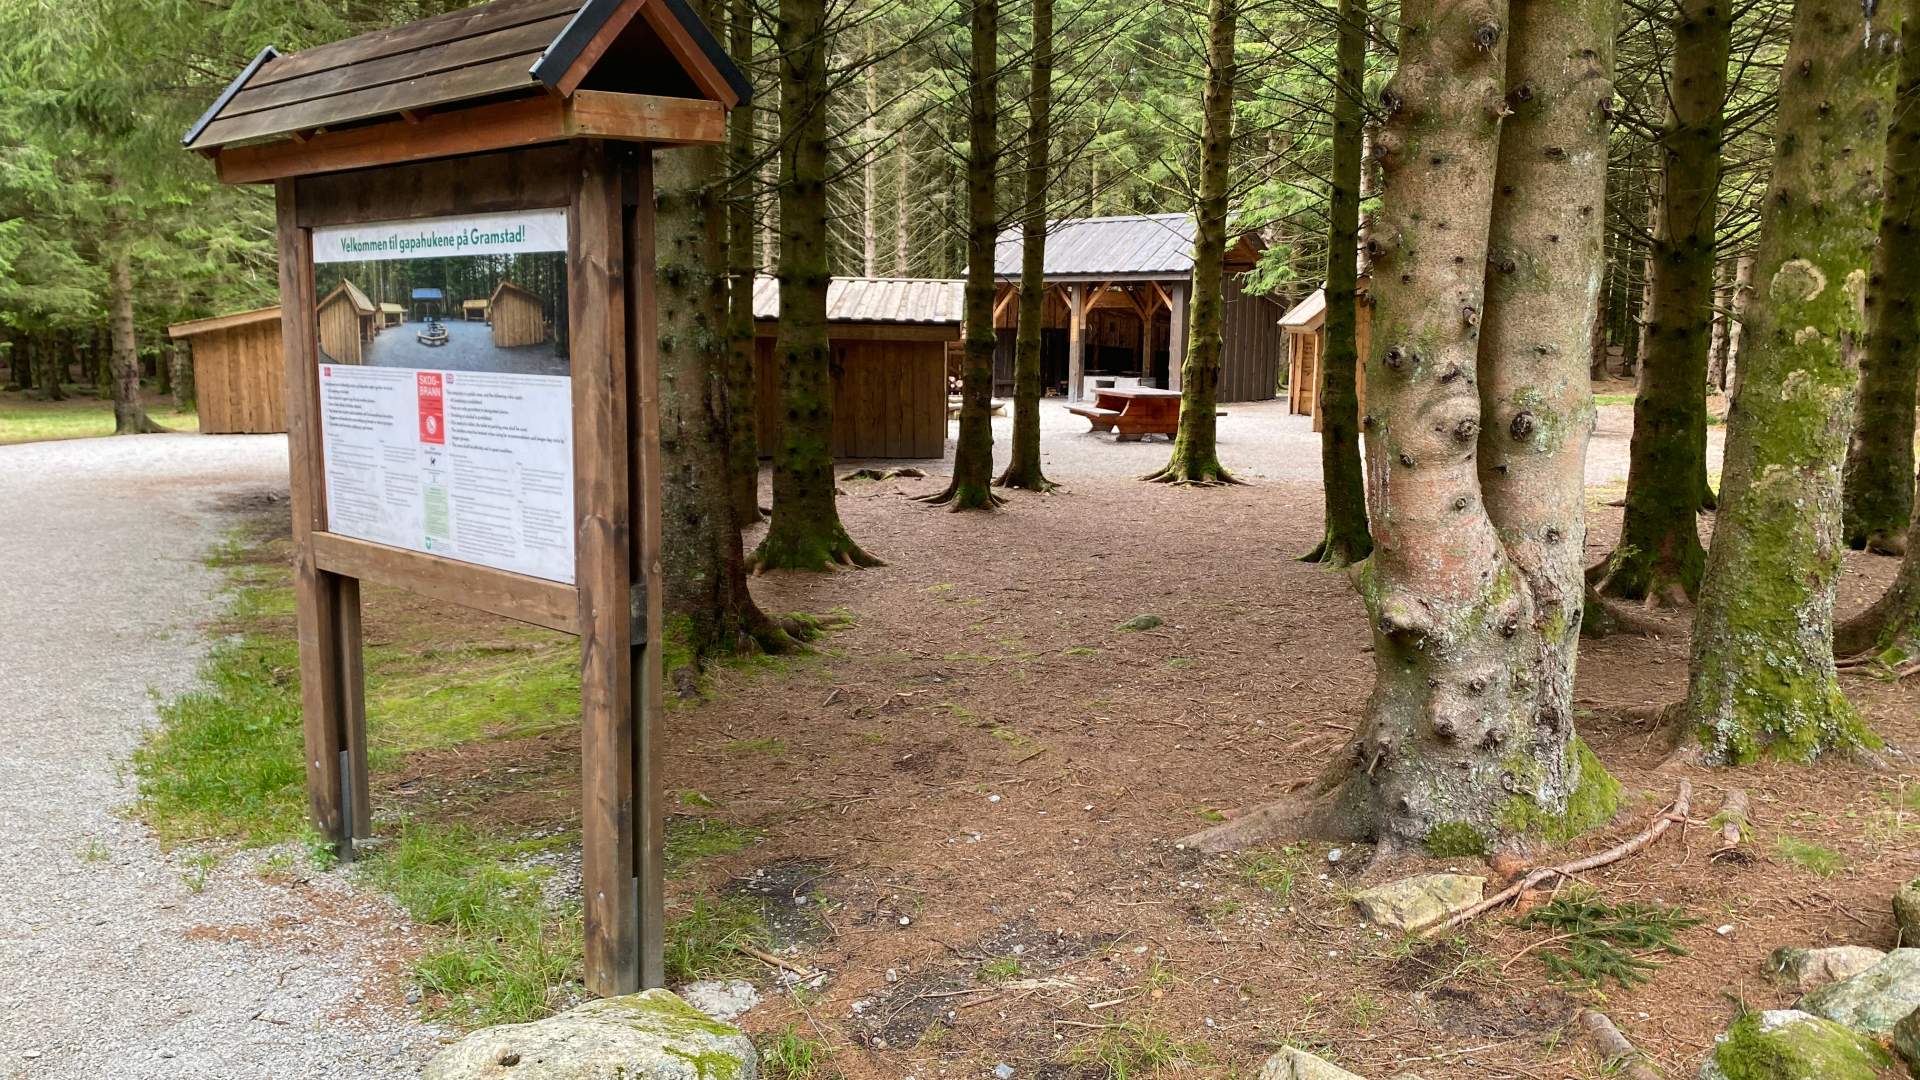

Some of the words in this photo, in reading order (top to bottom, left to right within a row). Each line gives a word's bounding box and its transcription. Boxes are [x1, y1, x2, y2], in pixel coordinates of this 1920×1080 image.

[340, 236, 388, 253] Velkommen
[389, 233, 398, 250] til
[399, 231, 454, 253] gapahukene
[456, 228, 469, 251] på
[470, 224, 525, 245] Gramstad!
